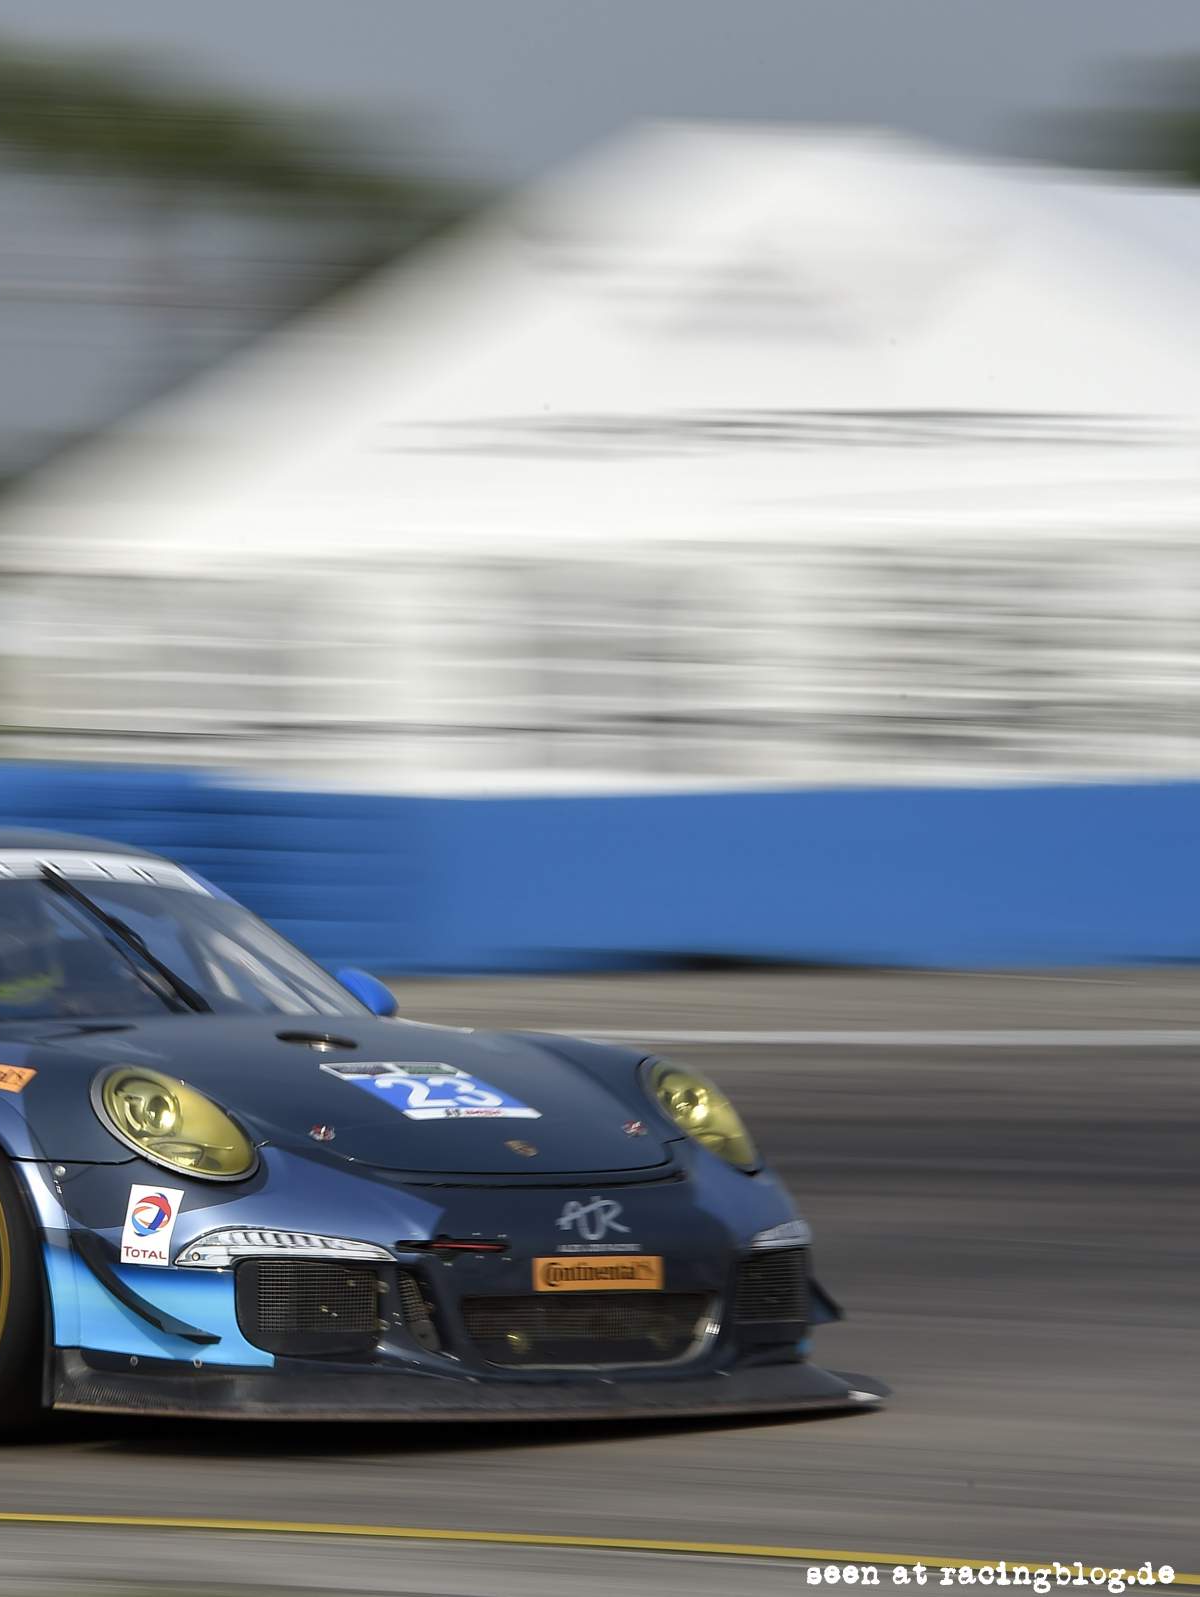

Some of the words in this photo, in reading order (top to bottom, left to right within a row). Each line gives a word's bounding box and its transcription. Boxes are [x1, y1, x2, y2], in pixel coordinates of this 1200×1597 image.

[375, 1074, 503, 1108] 23
[123, 1246, 167, 1260] TOTAL
[544, 1261, 635, 1287] Continental
